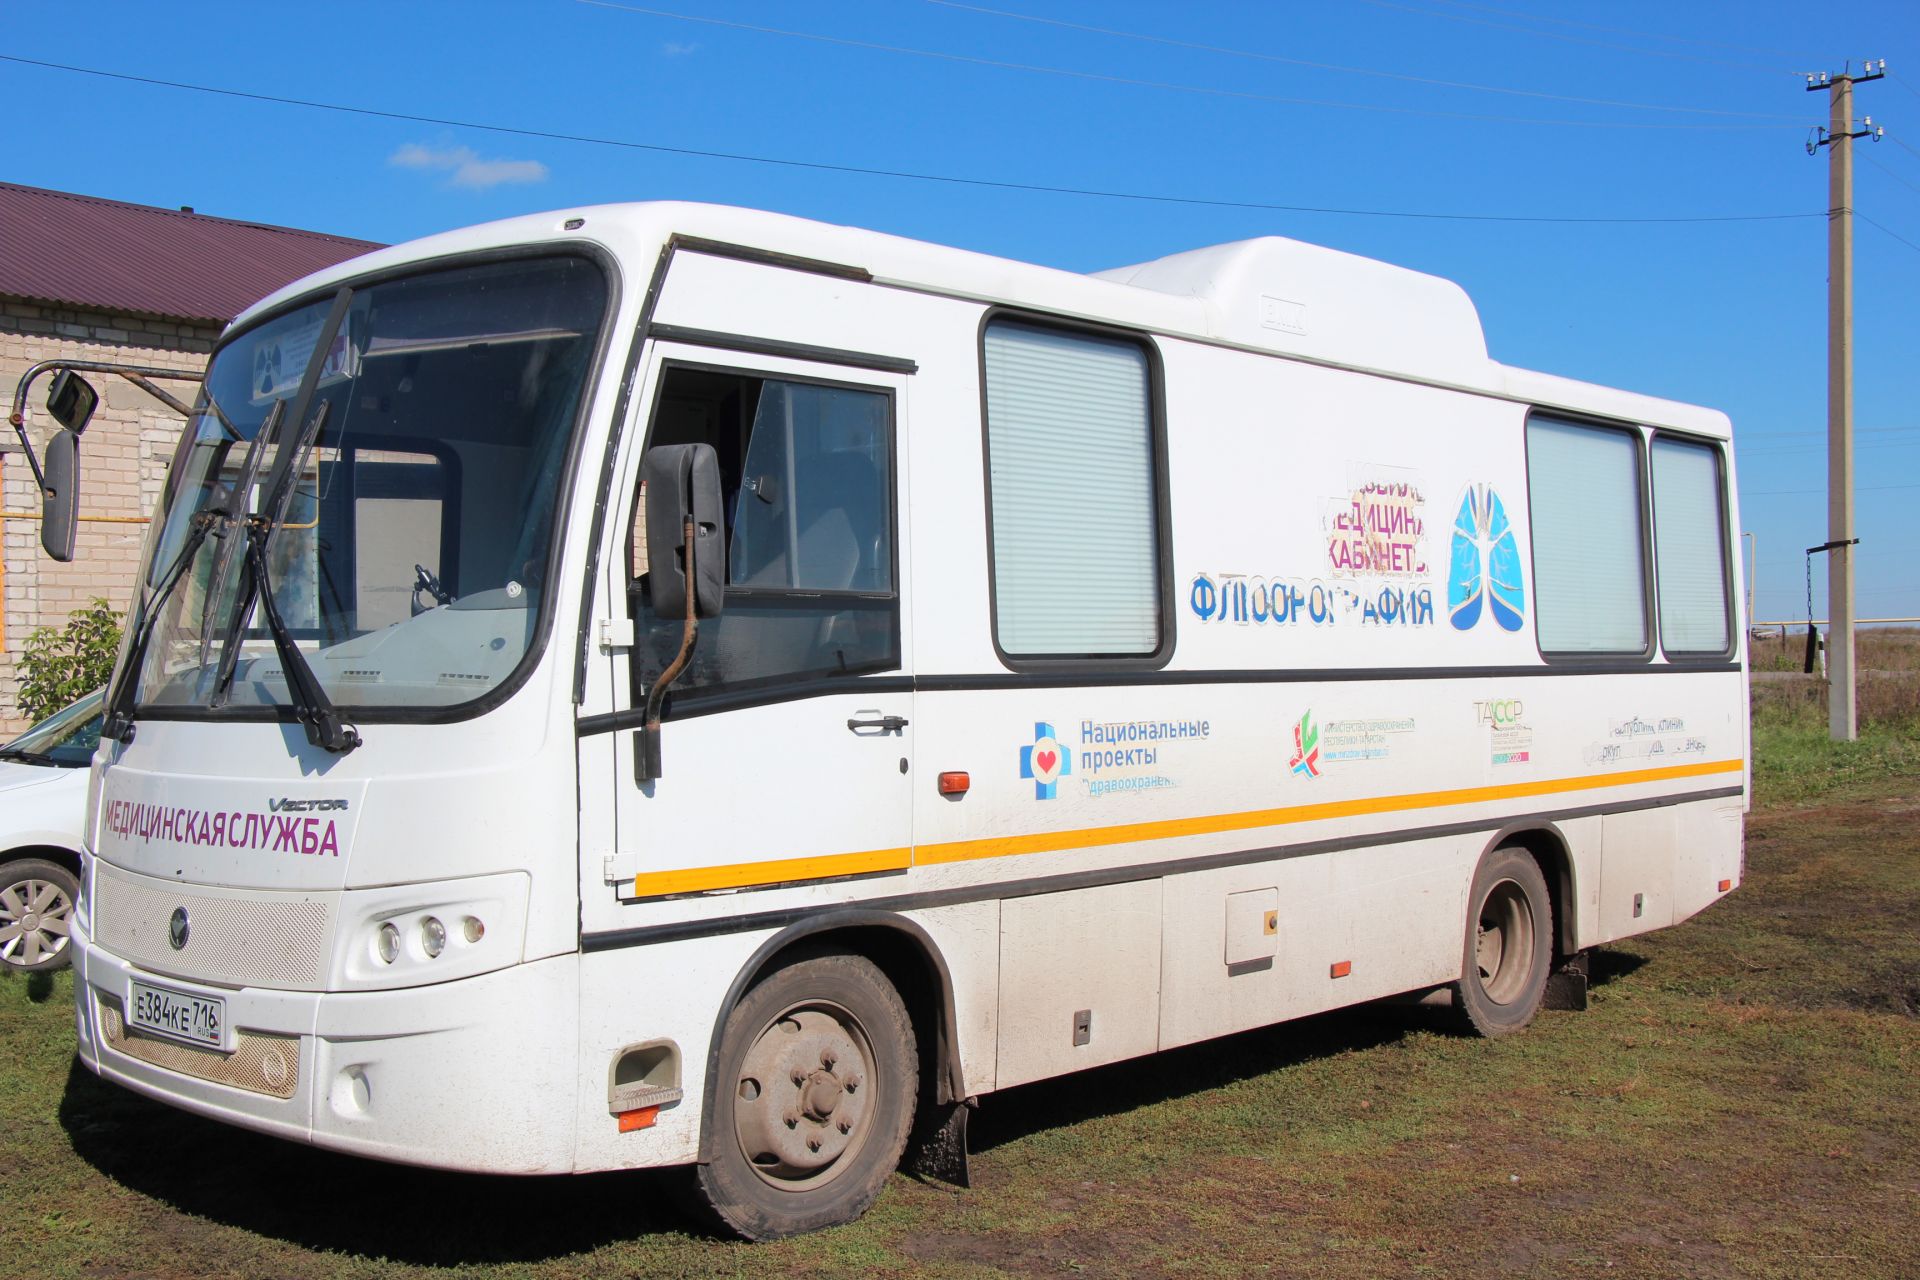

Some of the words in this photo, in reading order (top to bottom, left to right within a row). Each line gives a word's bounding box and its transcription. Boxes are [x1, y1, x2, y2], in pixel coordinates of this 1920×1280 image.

[1081, 719, 1210, 746] Национальные
[1081, 747, 1157, 773] проекты
[104, 799, 227, 848] МЕДИЦИНСКАЯ
[228, 811, 339, 857] СЛУЖБА
[192, 1001, 218, 1029] 716
[197, 1026, 210, 1038] RUS
